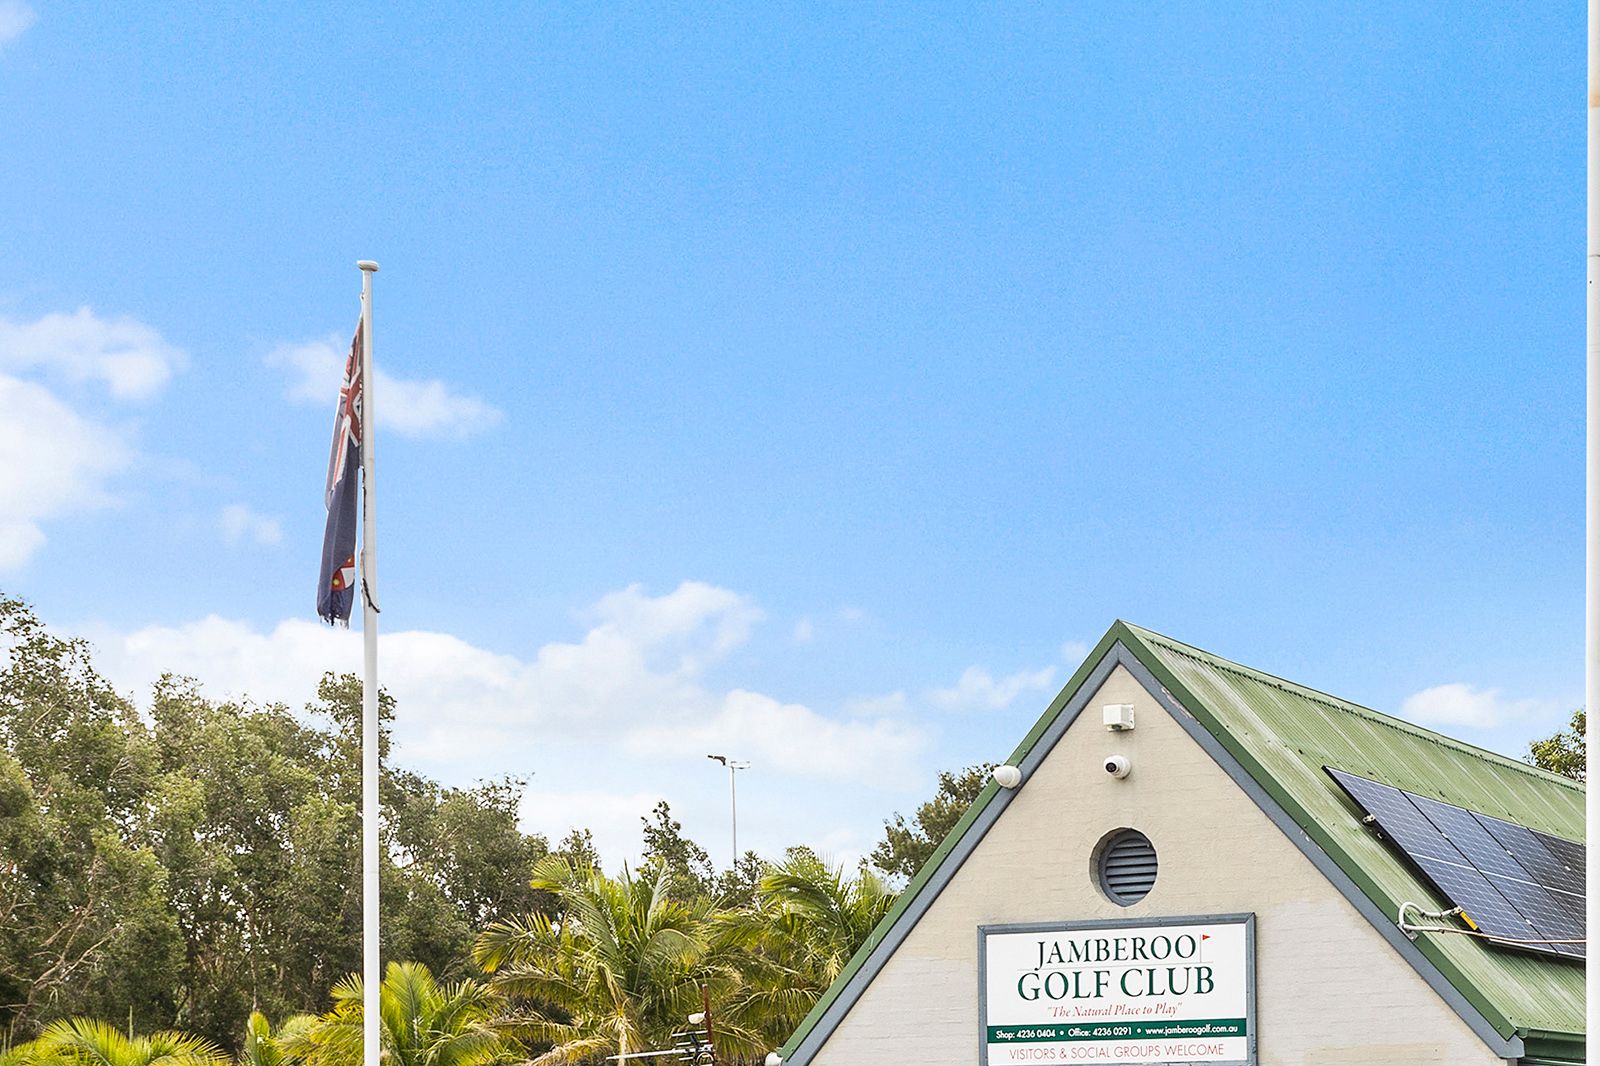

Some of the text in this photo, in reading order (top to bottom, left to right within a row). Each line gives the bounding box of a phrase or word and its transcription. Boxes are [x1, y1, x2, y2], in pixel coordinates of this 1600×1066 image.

[1034, 934, 1197, 971] JAMBEROO
[1017, 966, 1215, 1001] GOLF CLUB
[1073, 1004, 1112, 1017] Natural
[1114, 1004, 1140, 1015] Place
[1143, 1005, 1152, 1014] to
[996, 1024, 1238, 1040] Shop: 4236 0404 Office: 4236 0291 www.jamberoogolf.com.au
[1009, 1044, 1224, 1060] VISITORS & SOCIAL GROUPS WELCOME
